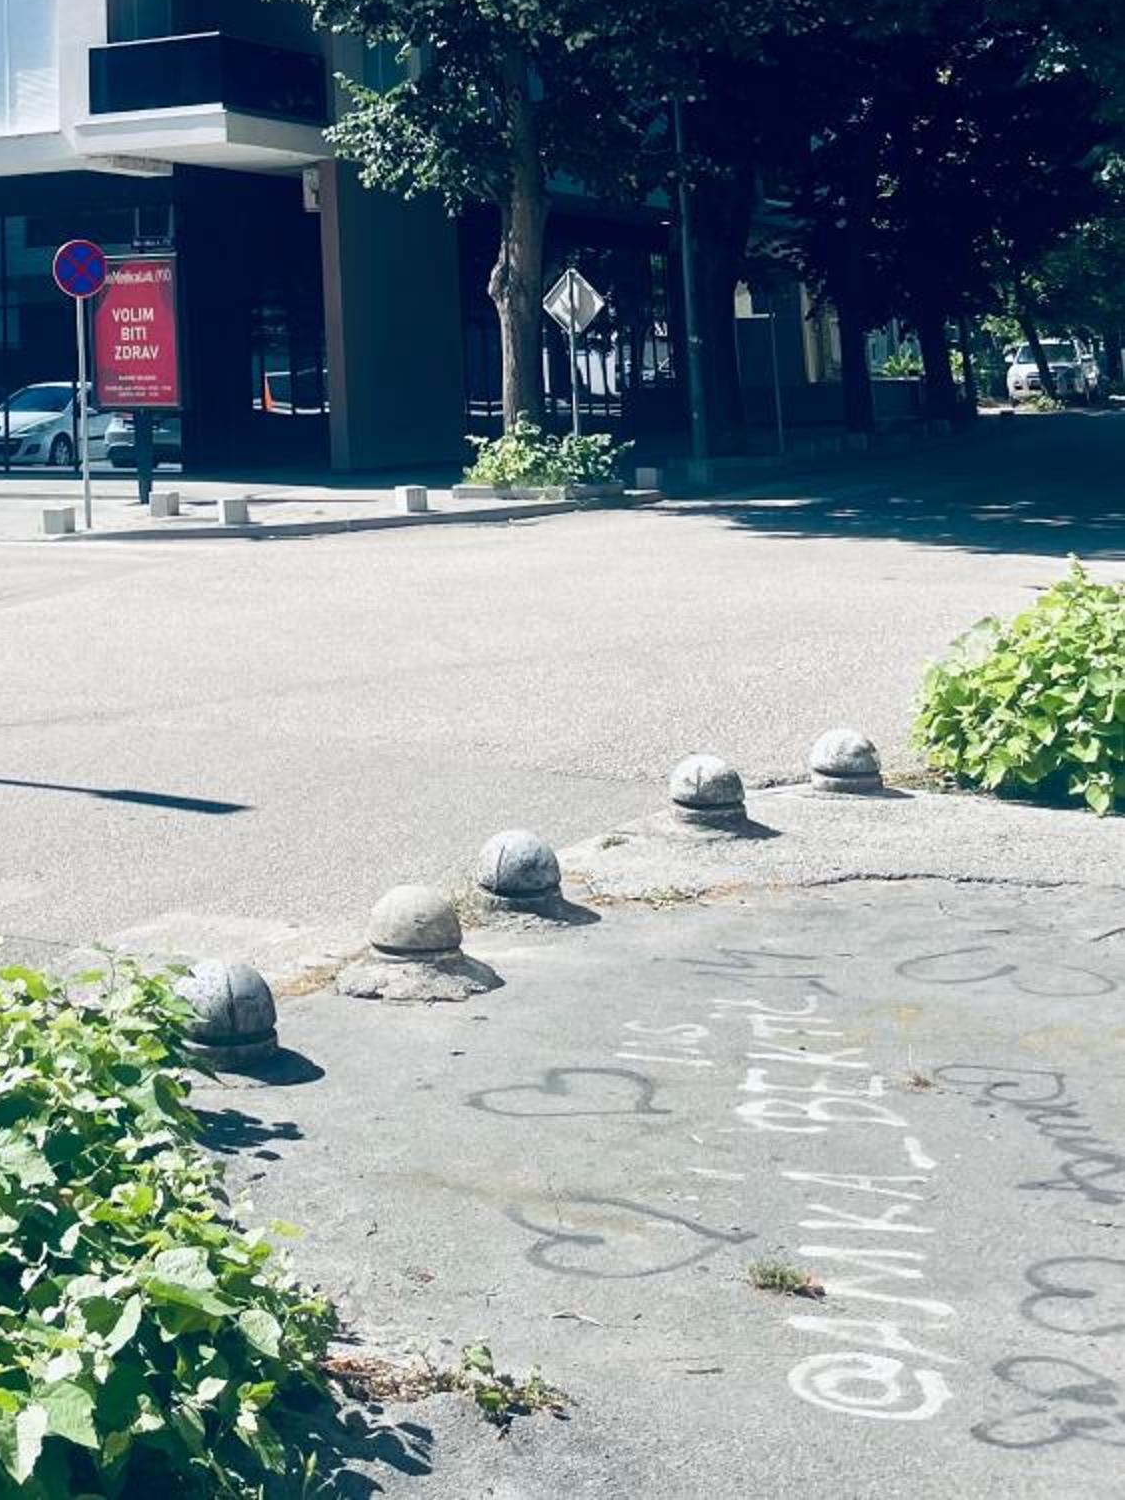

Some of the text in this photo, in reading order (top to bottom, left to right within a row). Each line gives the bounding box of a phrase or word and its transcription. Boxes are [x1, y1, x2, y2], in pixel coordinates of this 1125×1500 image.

[112, 307, 154, 322] VOLIM
[121, 327, 146, 341] BITI
[114, 345, 159, 361] ZDRAV
